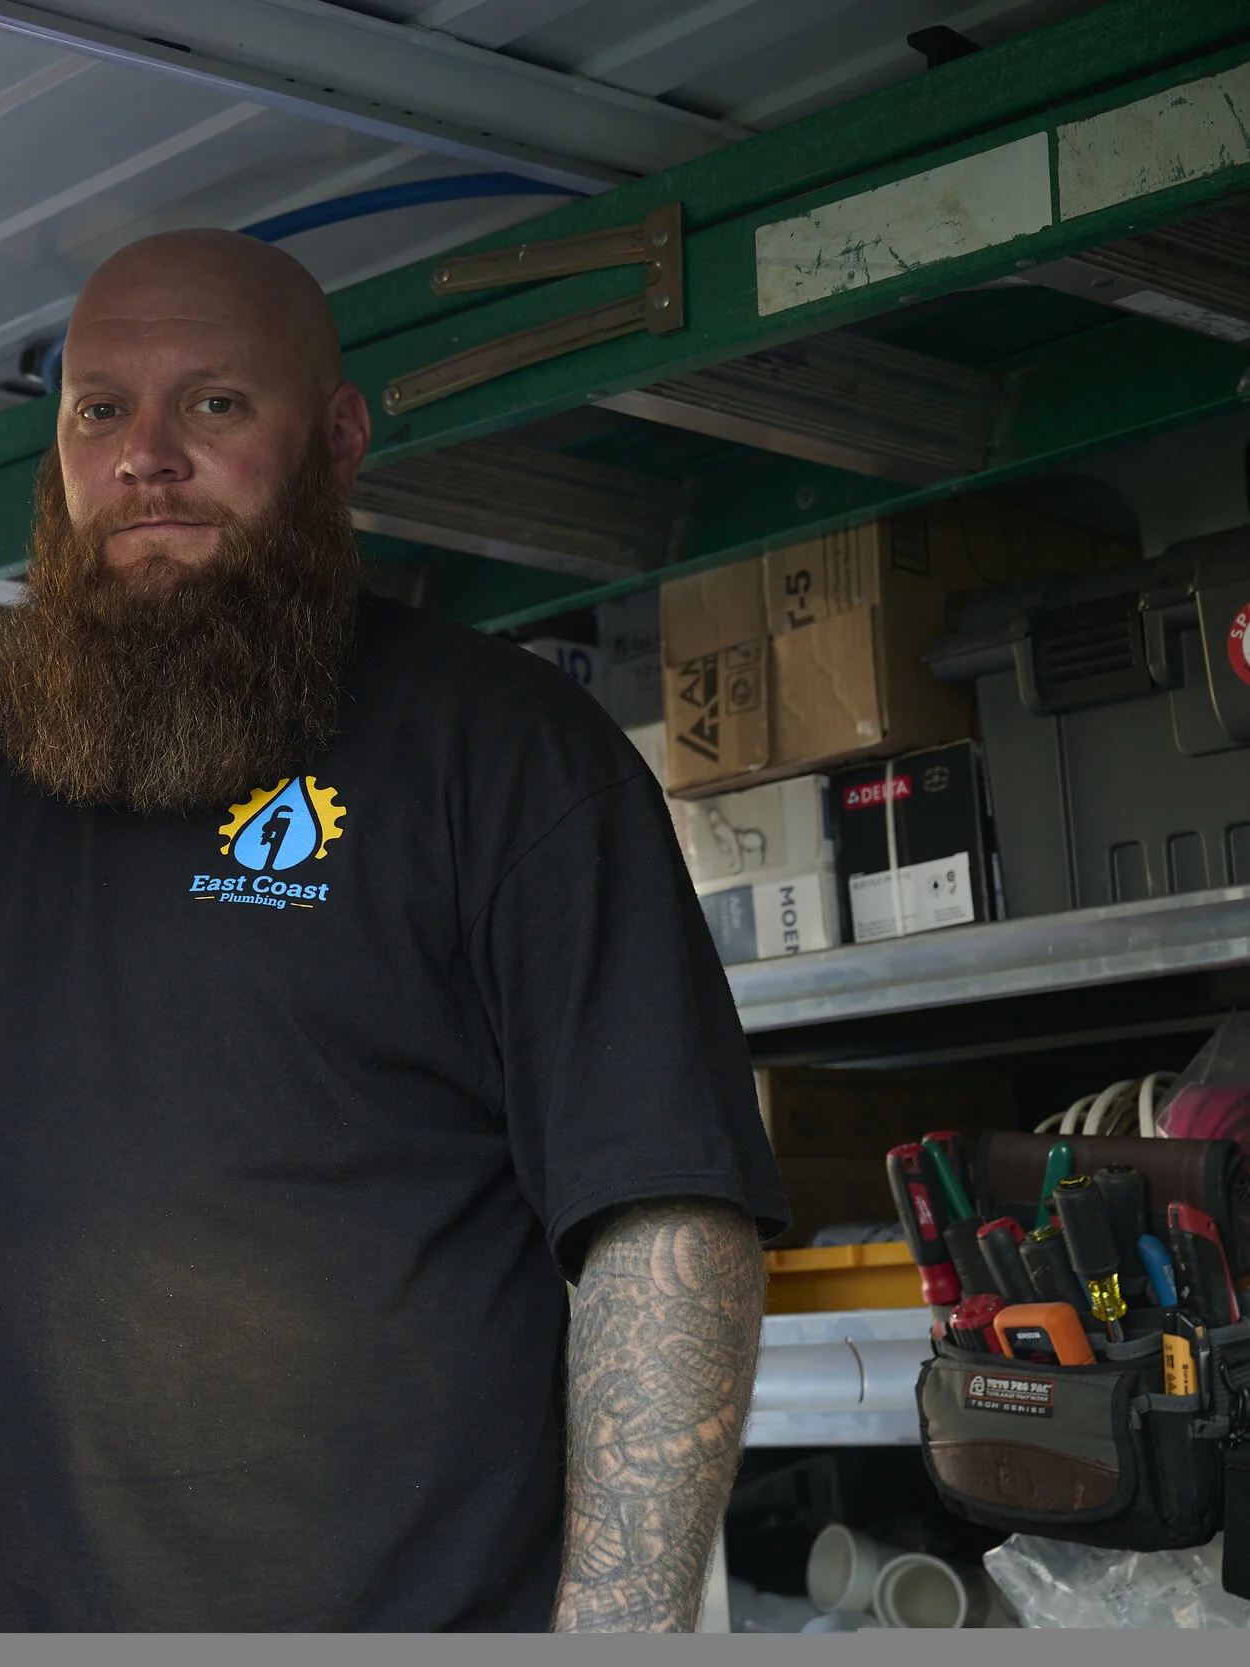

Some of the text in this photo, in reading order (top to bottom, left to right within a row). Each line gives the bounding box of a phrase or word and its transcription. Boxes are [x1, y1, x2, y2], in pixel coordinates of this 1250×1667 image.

[189, 875, 330, 902] East Coast
[219, 892, 287, 910] Plumbing
[971, 1399, 1046, 1414] TECH SERIES
